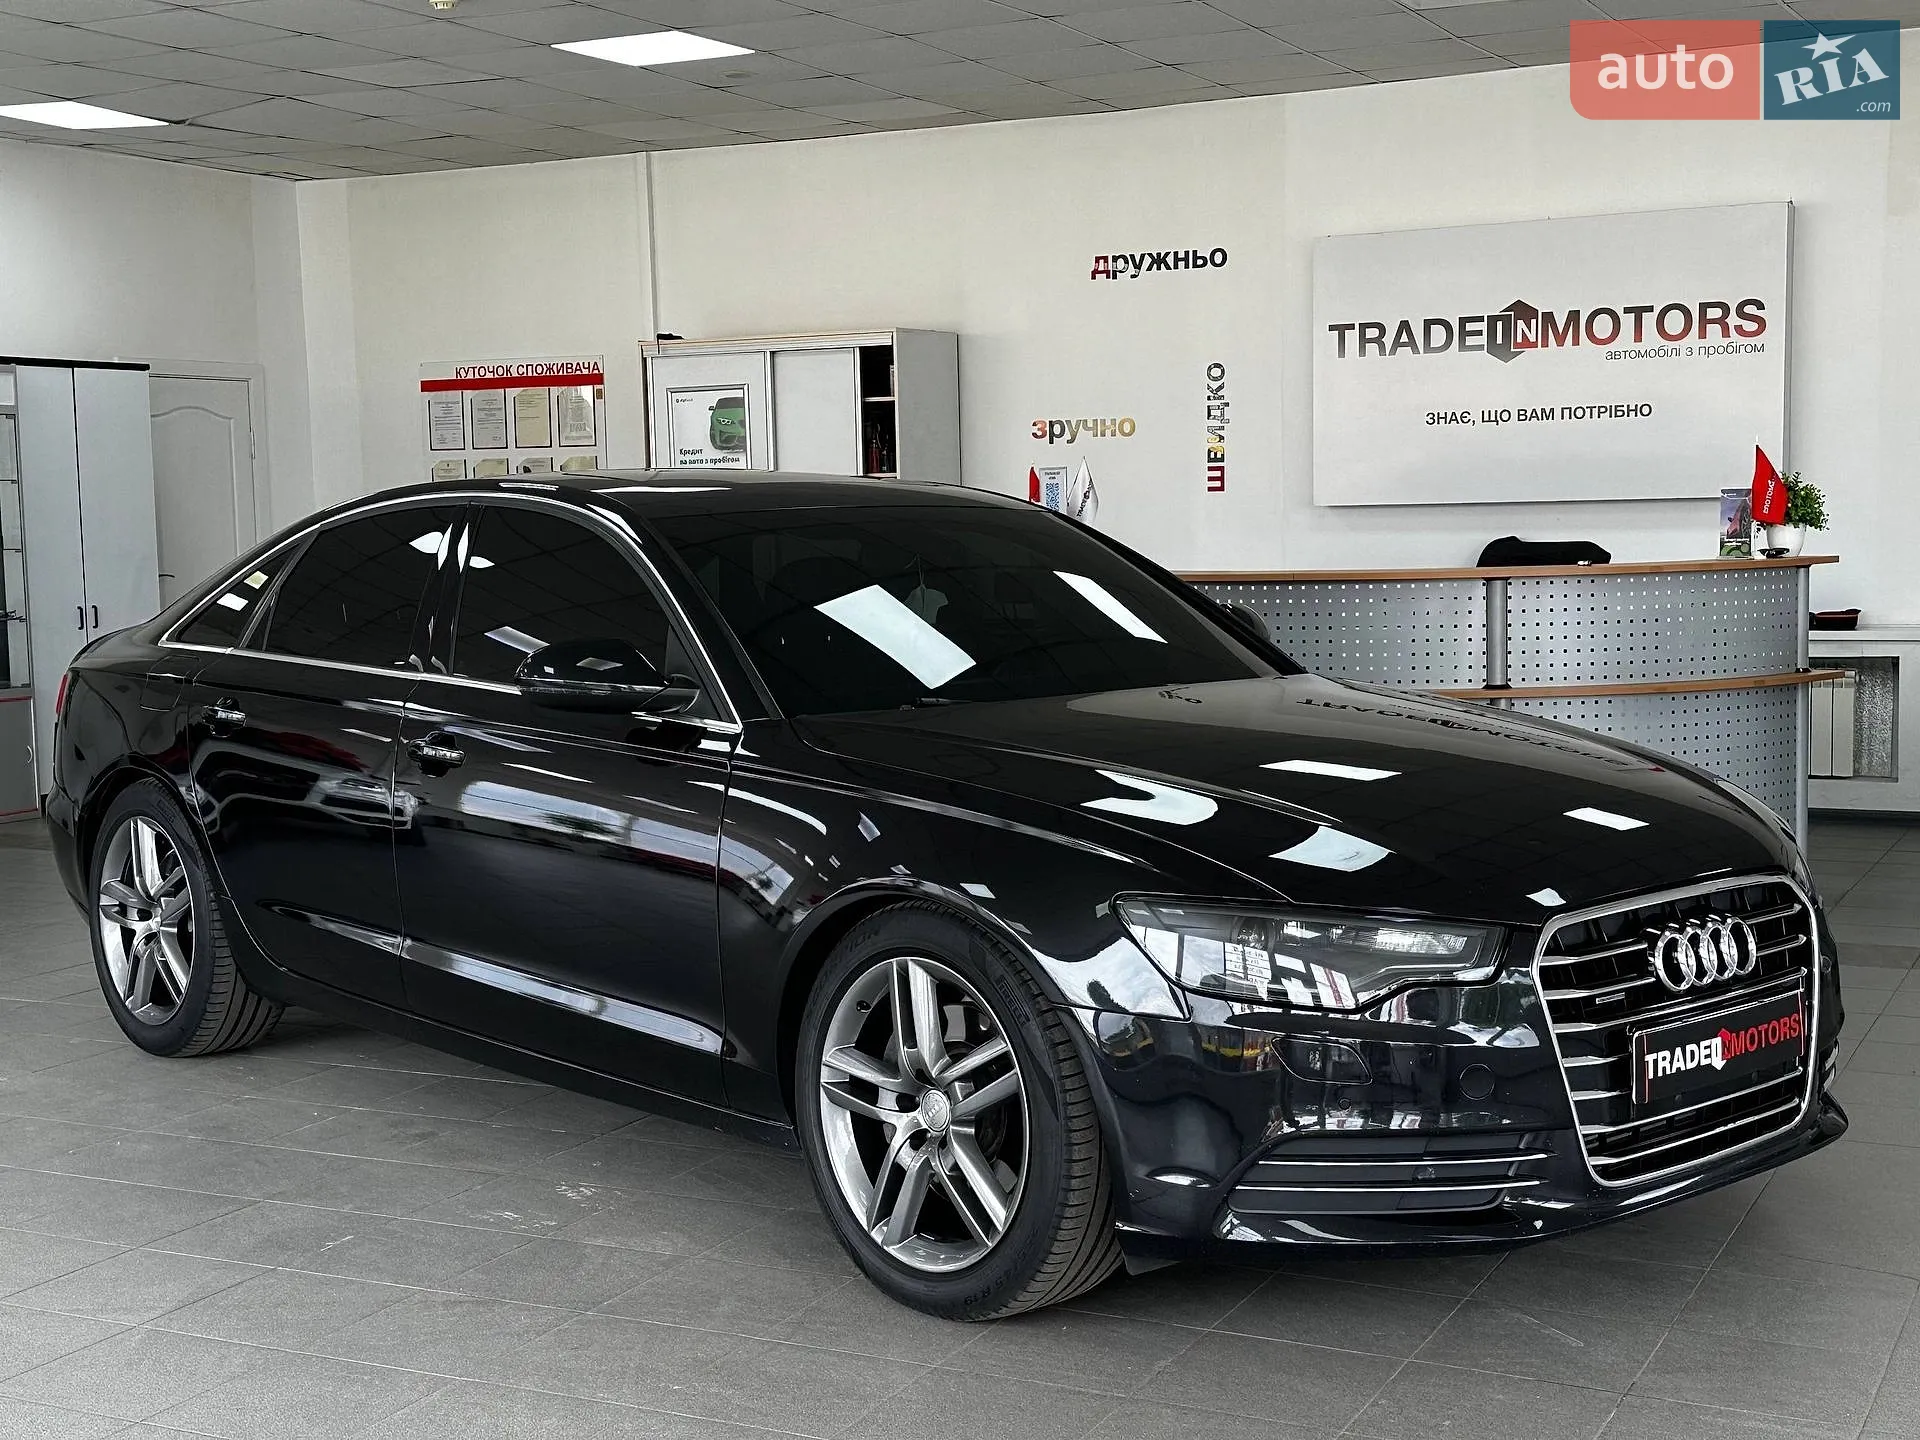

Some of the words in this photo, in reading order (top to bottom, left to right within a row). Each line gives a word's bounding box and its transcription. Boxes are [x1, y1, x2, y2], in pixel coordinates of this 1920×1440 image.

[1090, 247, 1228, 281] дружньо
[1605, 344, 1682, 361] автомобілі
[1685, 345, 1694, 357] з
[1698, 341, 1765, 359] пробігом
[455, 364, 514, 379] КУТОЧОК
[516, 361, 601, 377] СПОЖИВАЧА
[1425, 410, 1477, 427] ЗНАЄ,
[1481, 408, 1512, 426] ЩО
[1516, 407, 1555, 423] ВАМ
[1560, 403, 1653, 420] ПОТРІБНО
[1031, 416, 1136, 444] зручно
